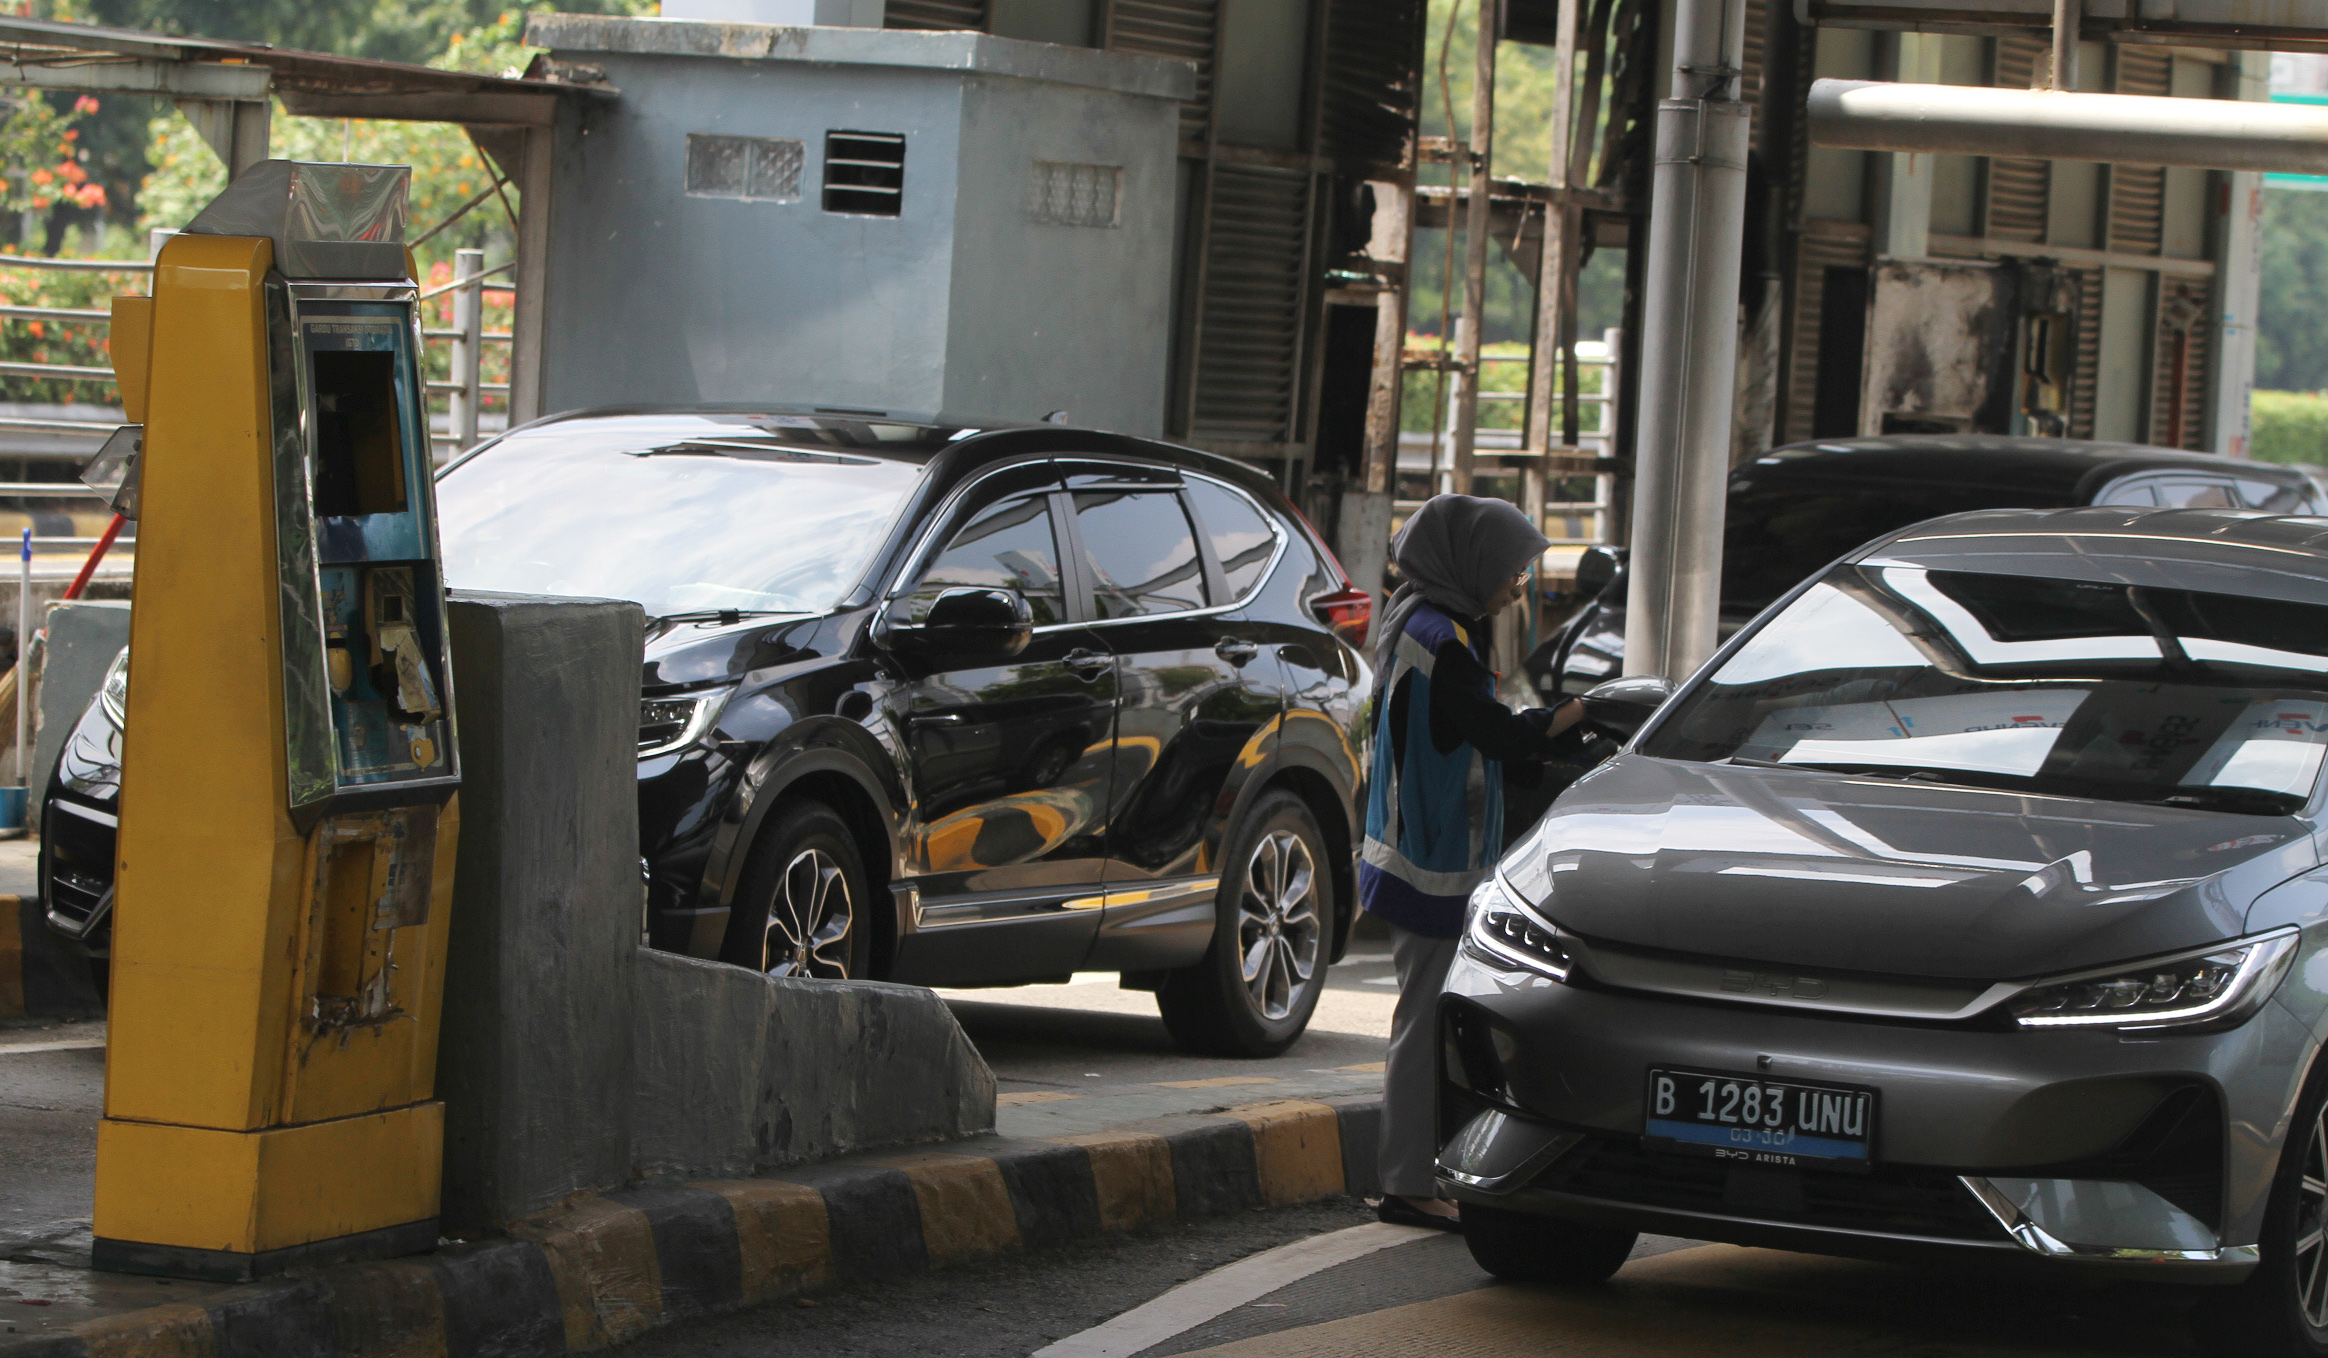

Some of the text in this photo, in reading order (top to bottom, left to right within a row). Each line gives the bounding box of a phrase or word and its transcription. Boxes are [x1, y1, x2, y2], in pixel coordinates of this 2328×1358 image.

[1655, 1076, 1864, 1137] B 1283 UNU
[1714, 1148, 1796, 1166] BYD ARISTA
